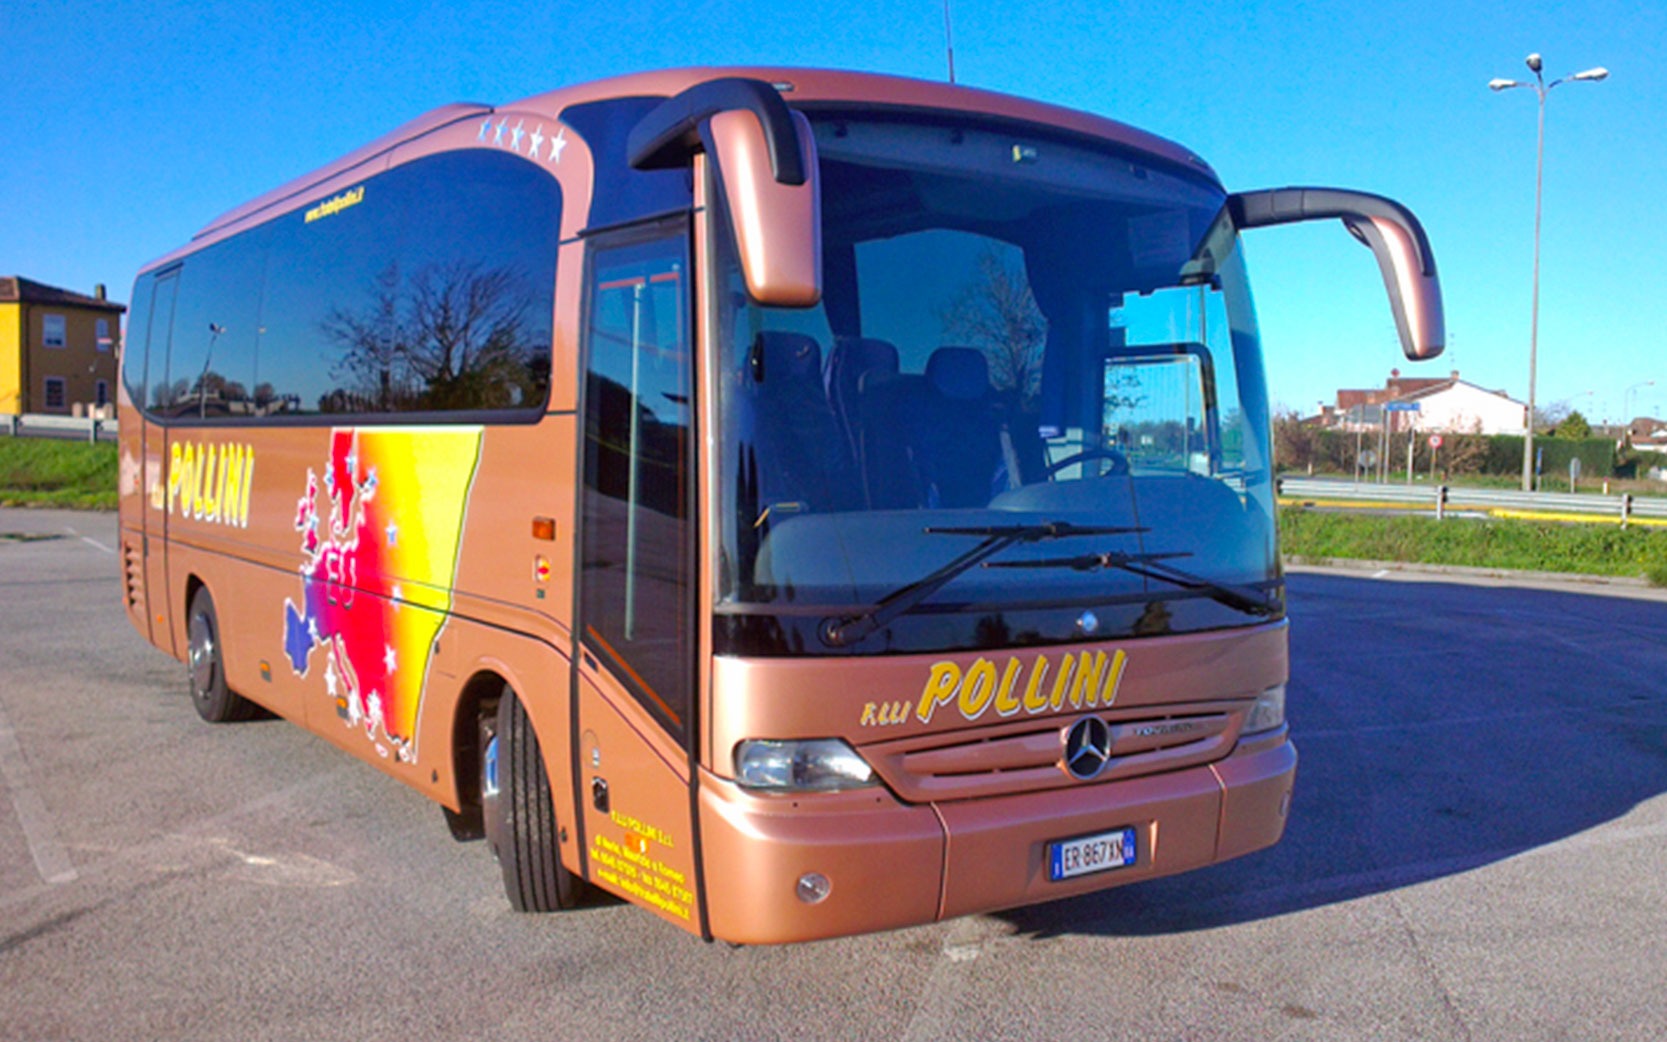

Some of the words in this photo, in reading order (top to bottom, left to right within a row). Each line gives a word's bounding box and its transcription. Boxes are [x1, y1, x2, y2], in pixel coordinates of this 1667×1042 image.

[167, 440, 255, 529] POLLINI
[916, 649, 1128, 724] POLLINI
[1064, 845, 1080, 872] ER
